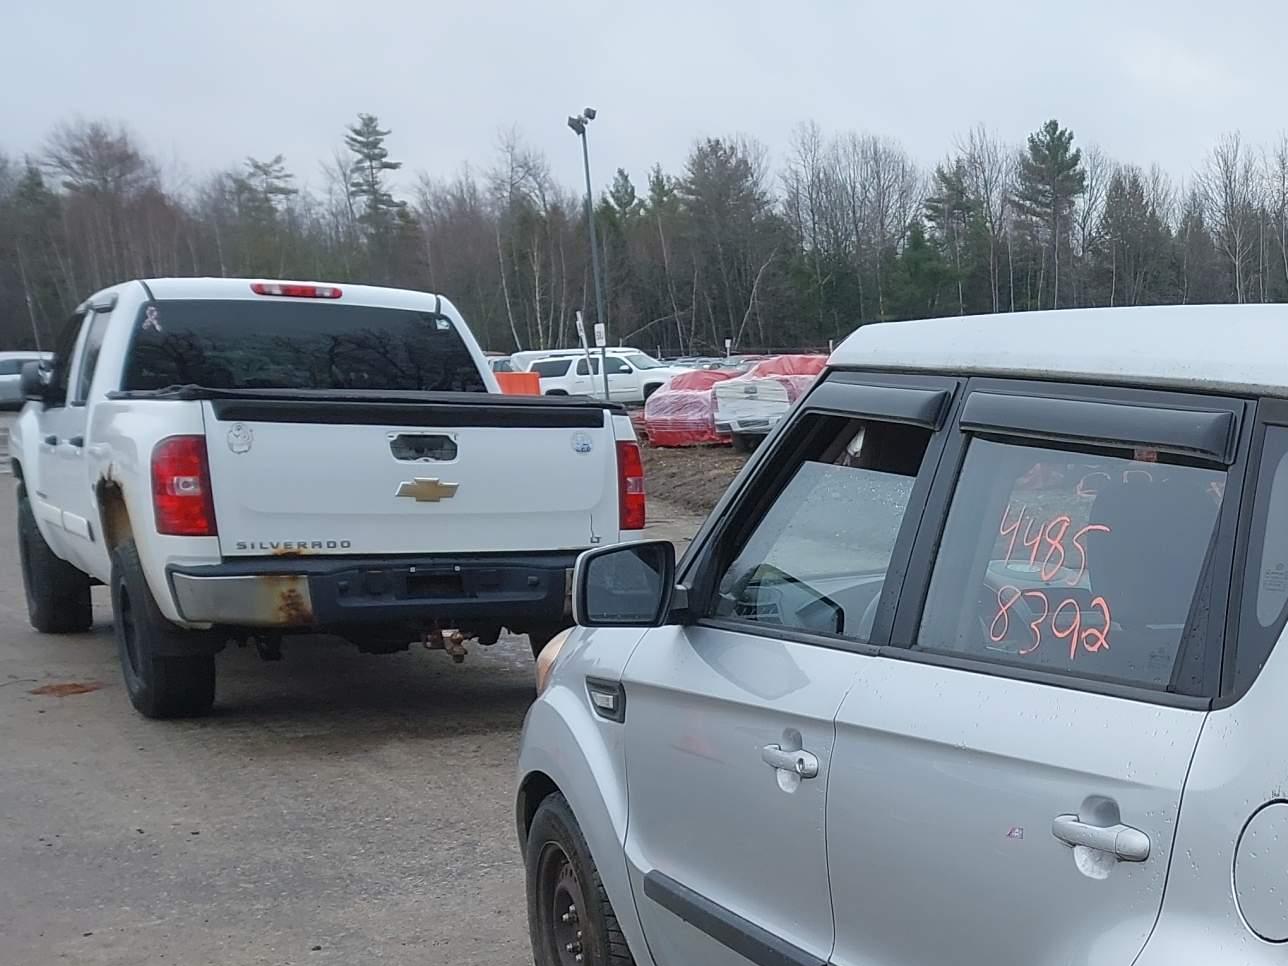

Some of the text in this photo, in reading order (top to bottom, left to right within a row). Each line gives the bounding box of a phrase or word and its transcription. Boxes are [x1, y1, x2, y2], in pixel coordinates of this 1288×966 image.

[236, 540, 352, 550] SILVERADO
[1000, 504, 1111, 586] 4485
[991, 585, 1111, 660] 8392
